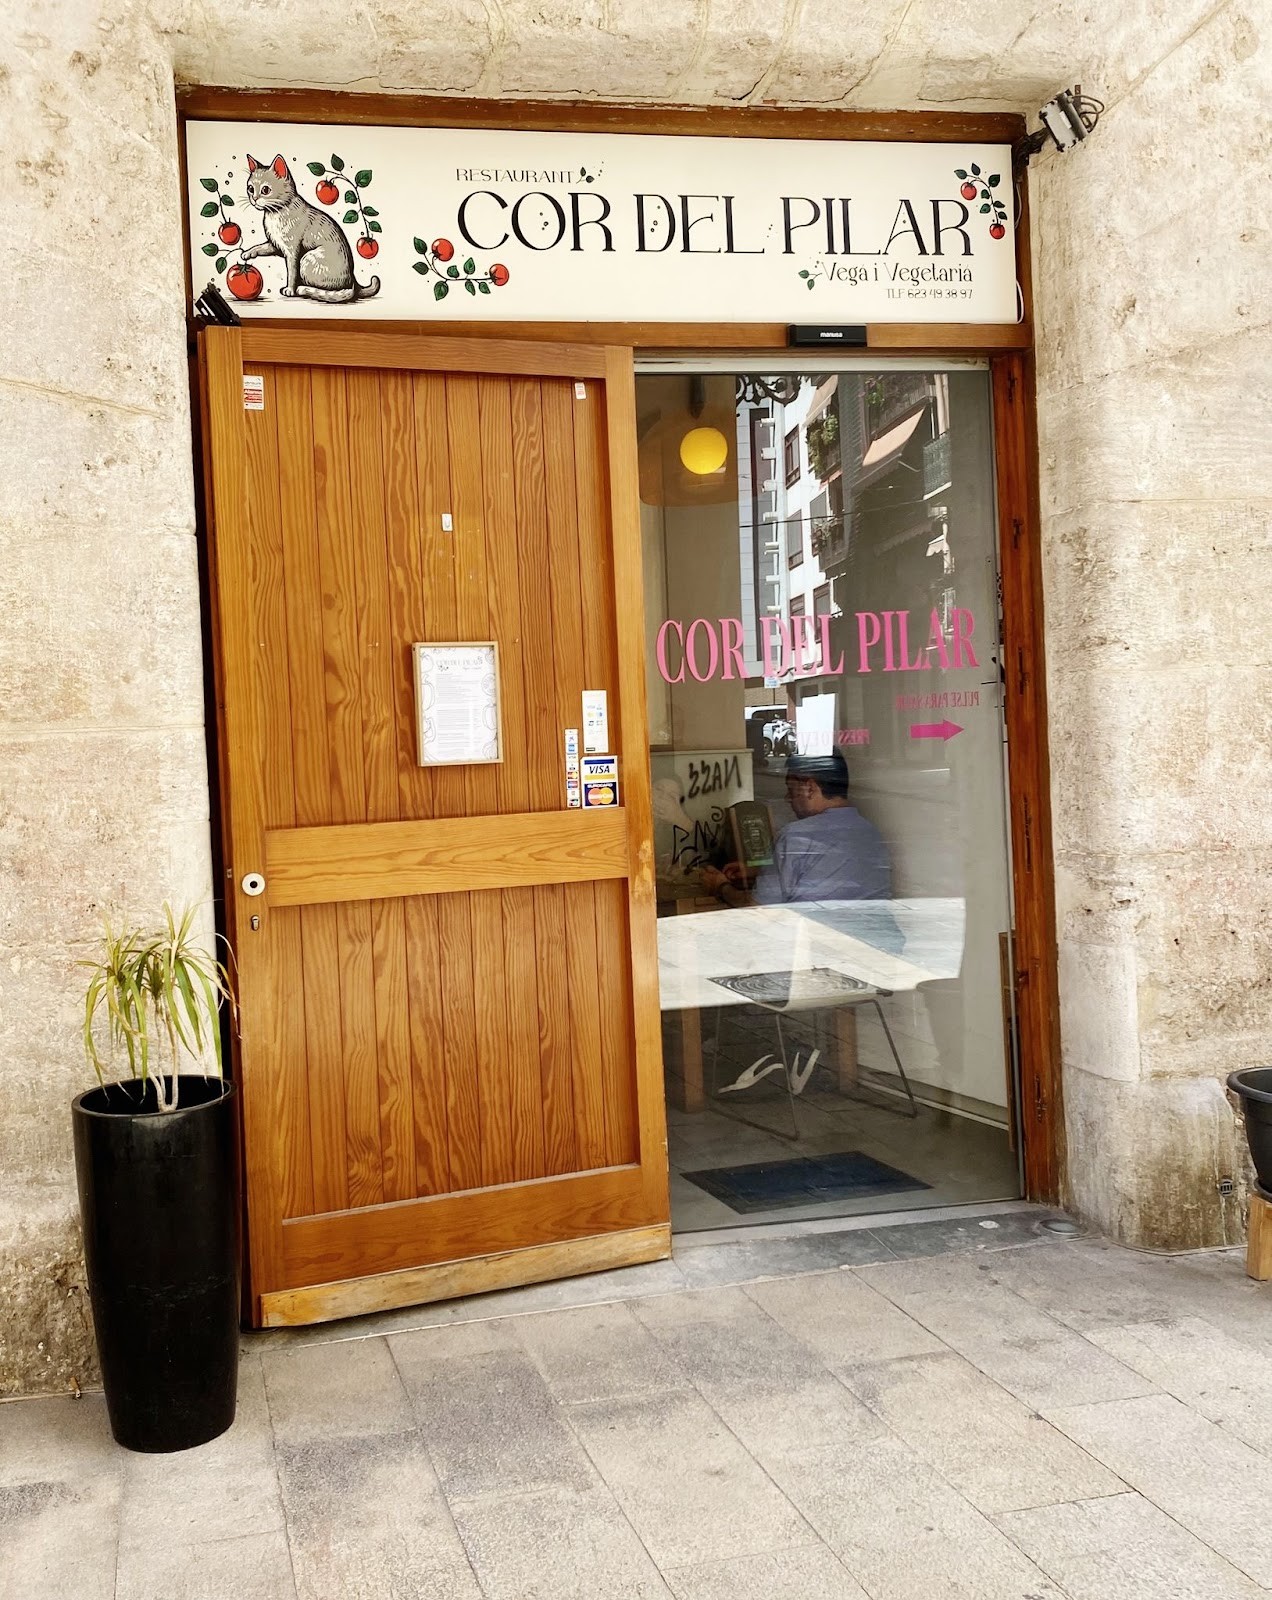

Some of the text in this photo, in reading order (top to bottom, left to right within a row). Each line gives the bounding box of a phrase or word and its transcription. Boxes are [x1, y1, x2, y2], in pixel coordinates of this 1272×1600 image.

[456, 168, 574, 184] RESTAURANT
[457, 190, 974, 256] COR DEL PILAR
[873, 262, 879, 282] i
[886, 288, 973, 299] TLF 623 49 38 97
[656, 607, 979, 683] COR DEL PILAR
[589, 765, 610, 774] VISA
